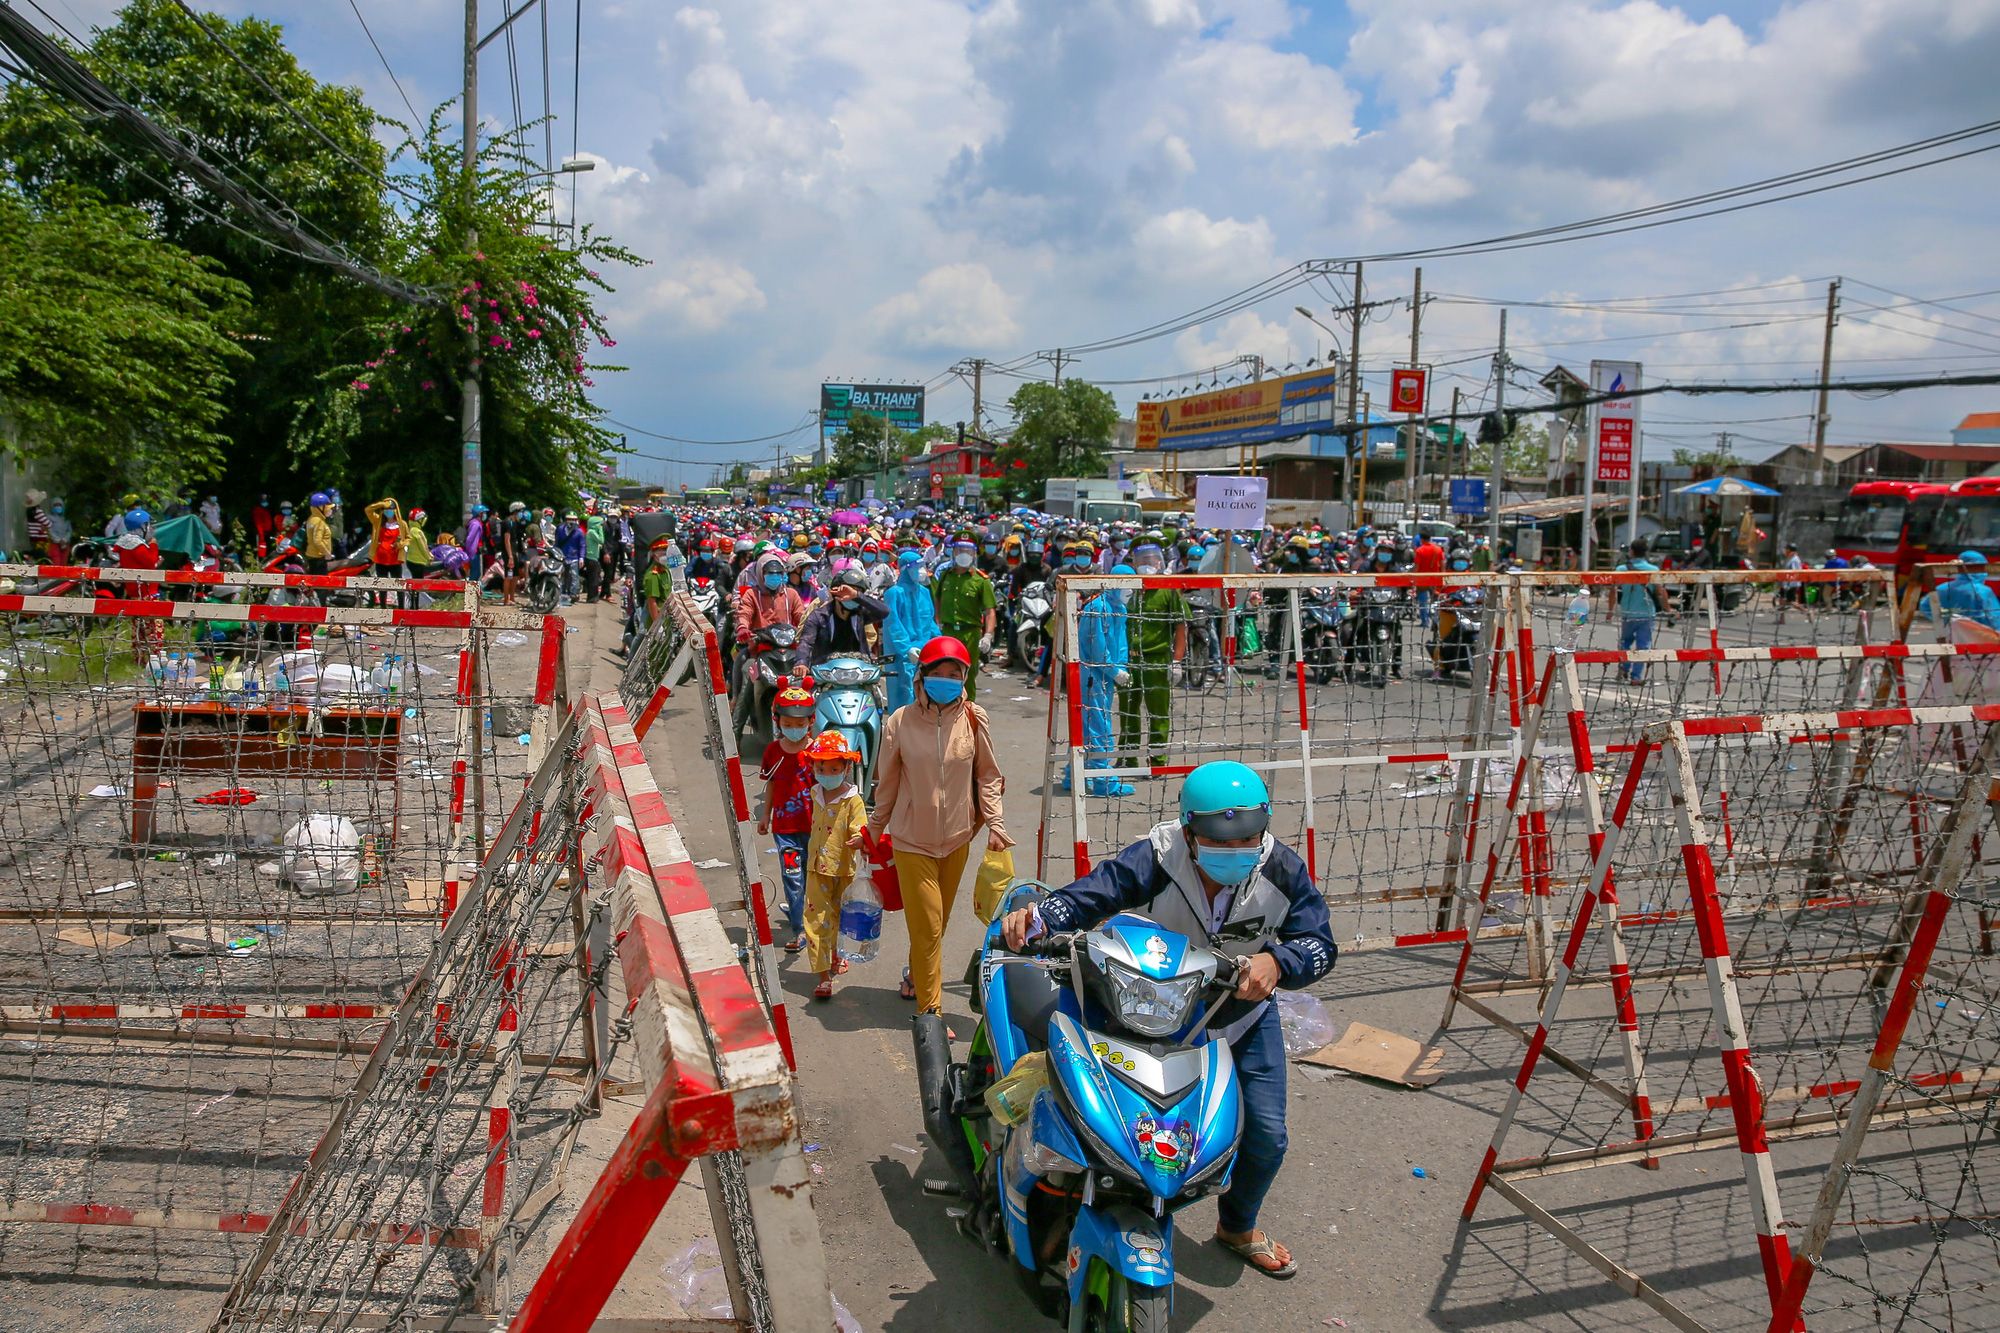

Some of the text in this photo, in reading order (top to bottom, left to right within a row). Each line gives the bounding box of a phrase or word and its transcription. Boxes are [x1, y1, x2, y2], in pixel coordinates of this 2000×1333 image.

[852, 391, 918, 406] BA THANH
[1224, 487, 1245, 497] TỈNH
[1207, 500, 1257, 510] HẬU GIANG
